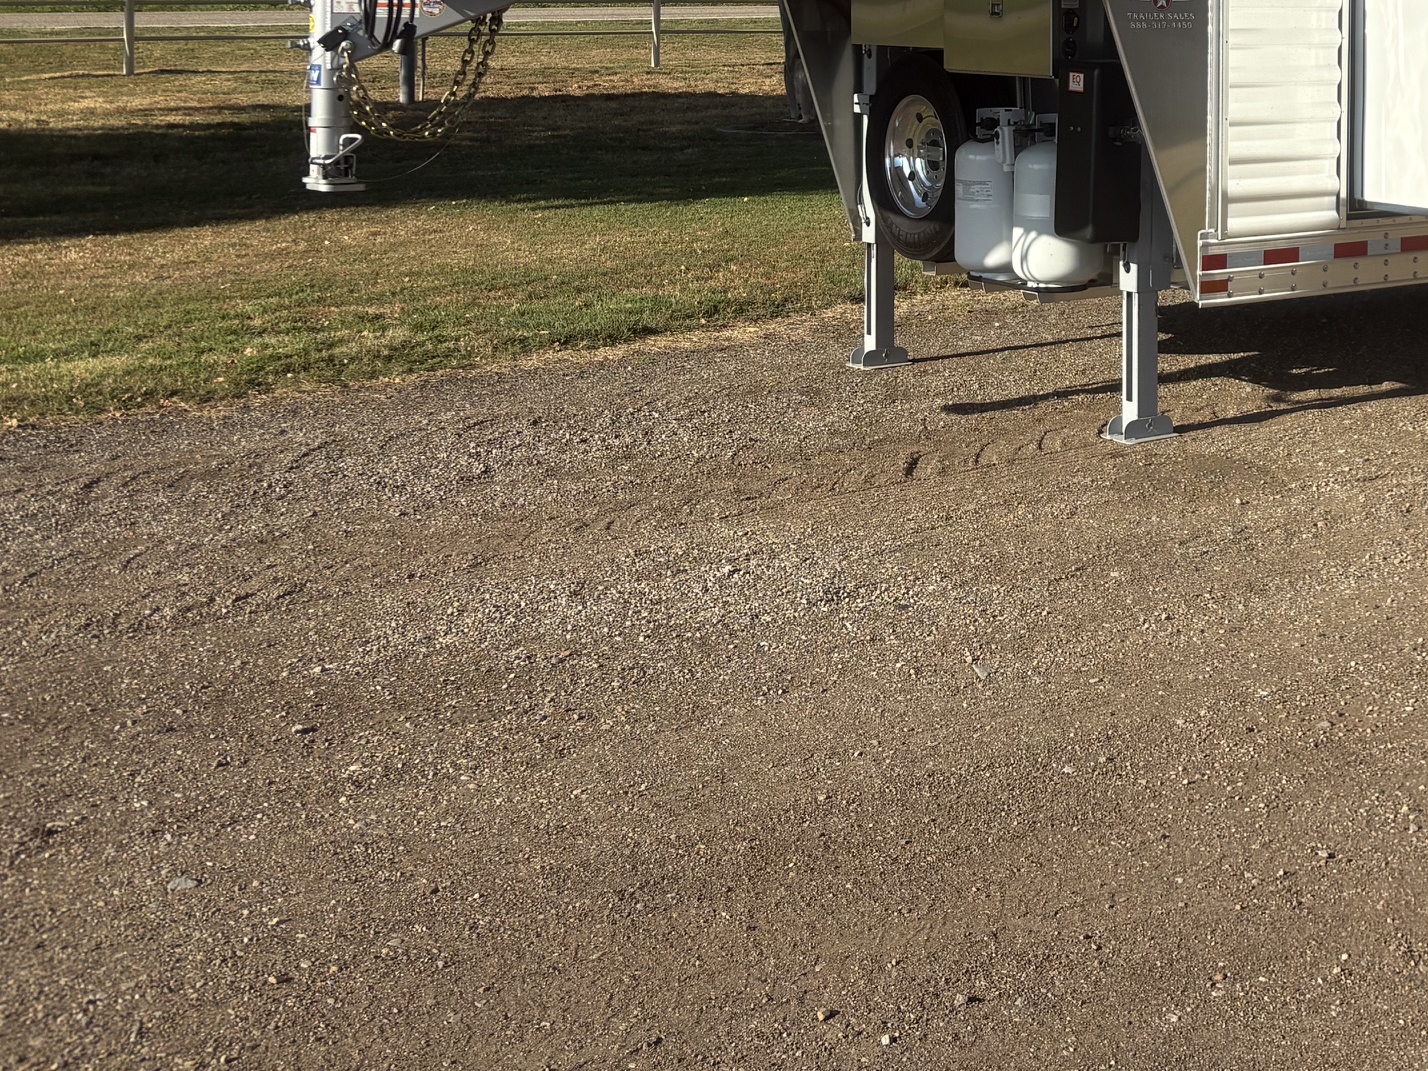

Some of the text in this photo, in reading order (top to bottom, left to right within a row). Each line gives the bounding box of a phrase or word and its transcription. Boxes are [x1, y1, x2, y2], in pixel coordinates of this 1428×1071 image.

[1127, 12, 1195, 20] TRAILER SALES
[1130, 21, 1193, 29] 888-317-4450
